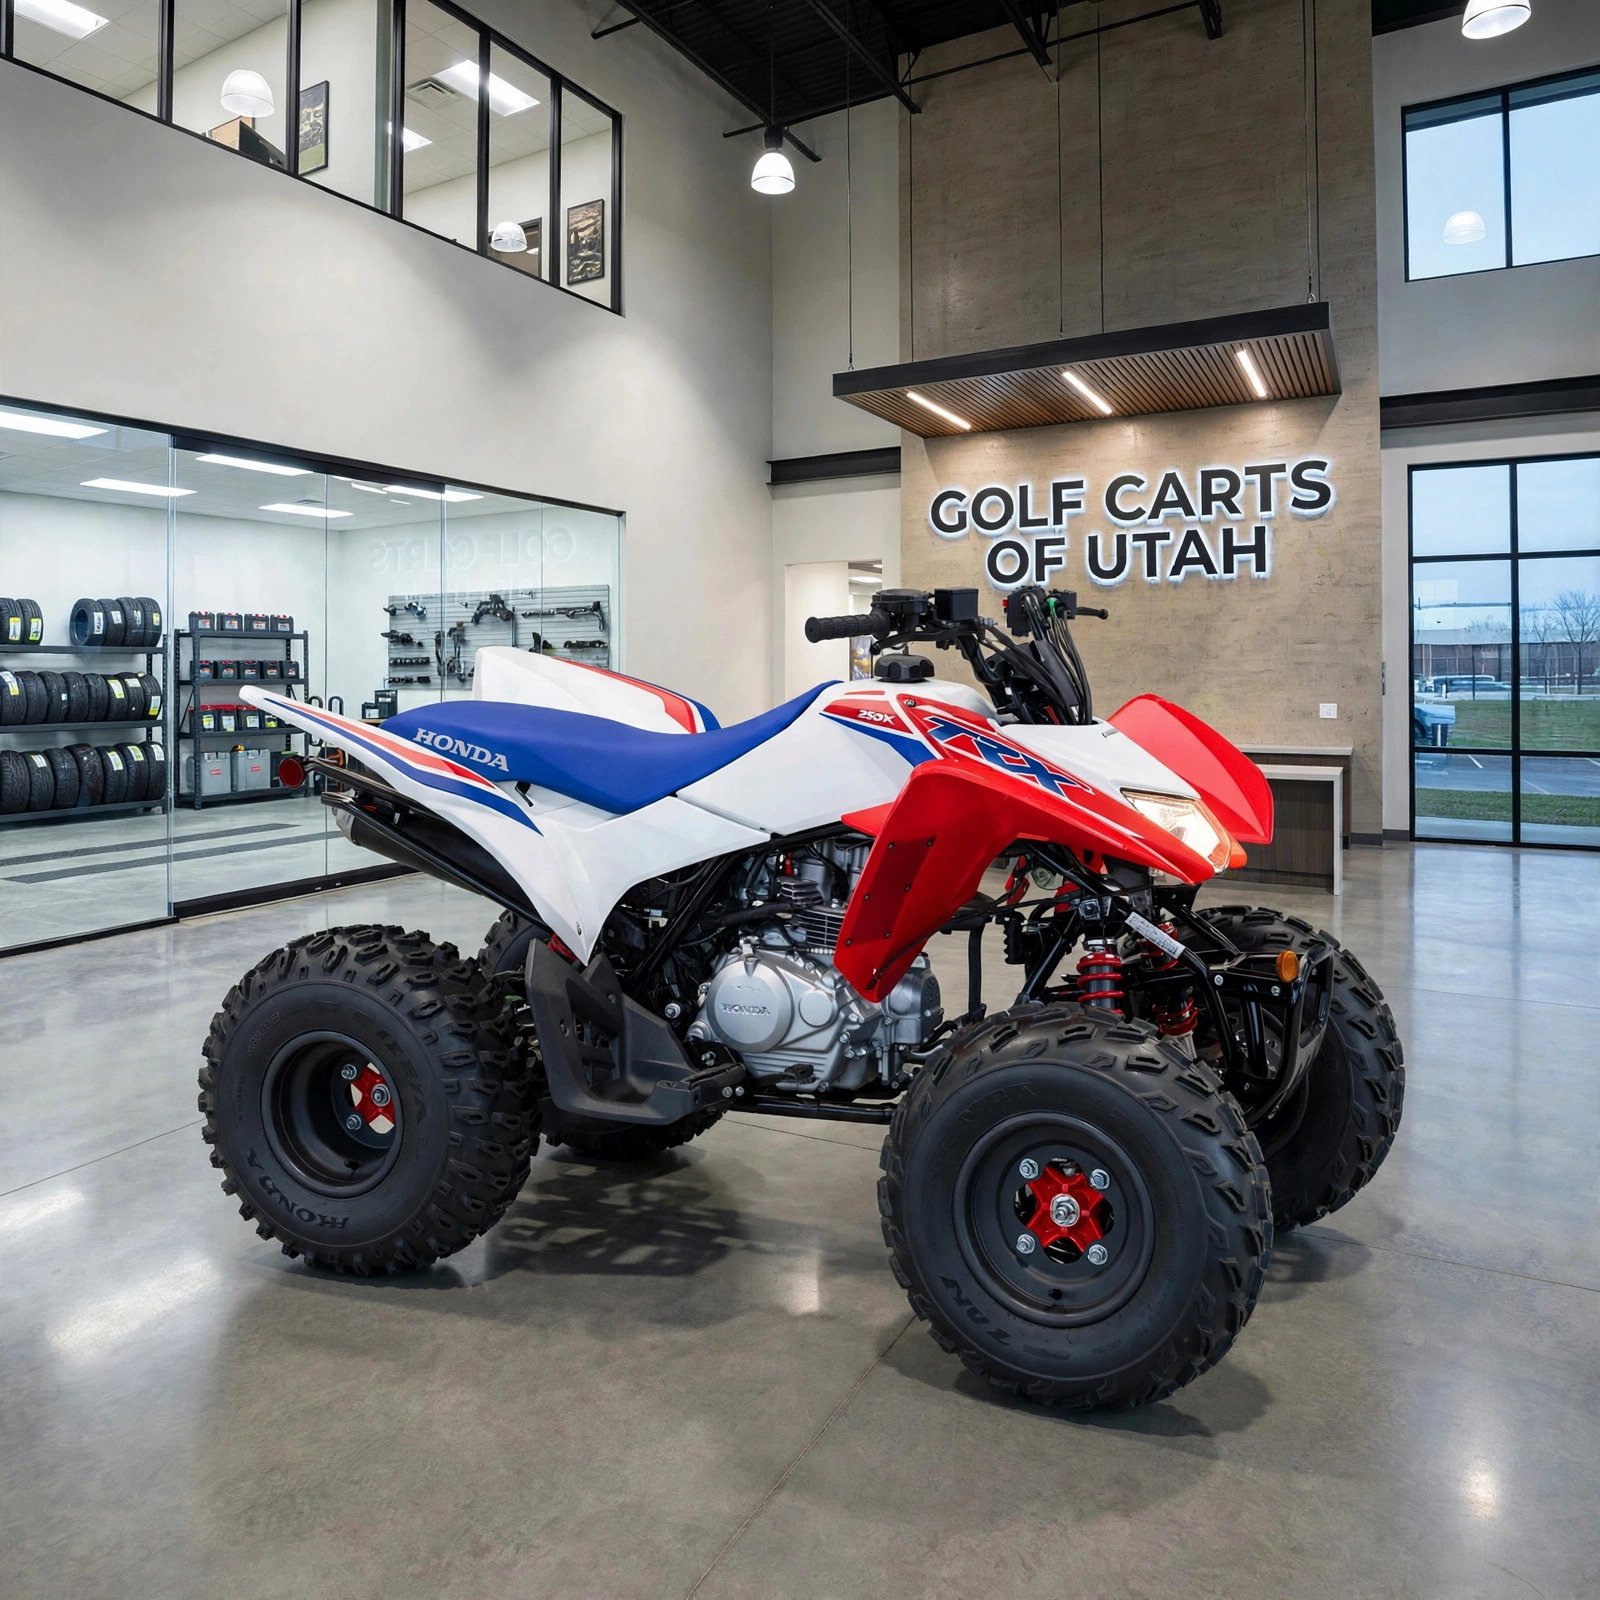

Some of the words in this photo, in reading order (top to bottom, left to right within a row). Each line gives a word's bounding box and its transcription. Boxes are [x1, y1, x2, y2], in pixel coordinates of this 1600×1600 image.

[930, 479, 1085, 534] GOLF
[1105, 460, 1333, 522] CARTS
[987, 537, 1066, 585] OF
[1087, 526, 1267, 580] UTAH
[858, 709, 896, 726] 250X
[413, 728, 510, 772] HONDA
[923, 715, 1081, 798] TRX
[721, 1002, 771, 1016] HONDA
